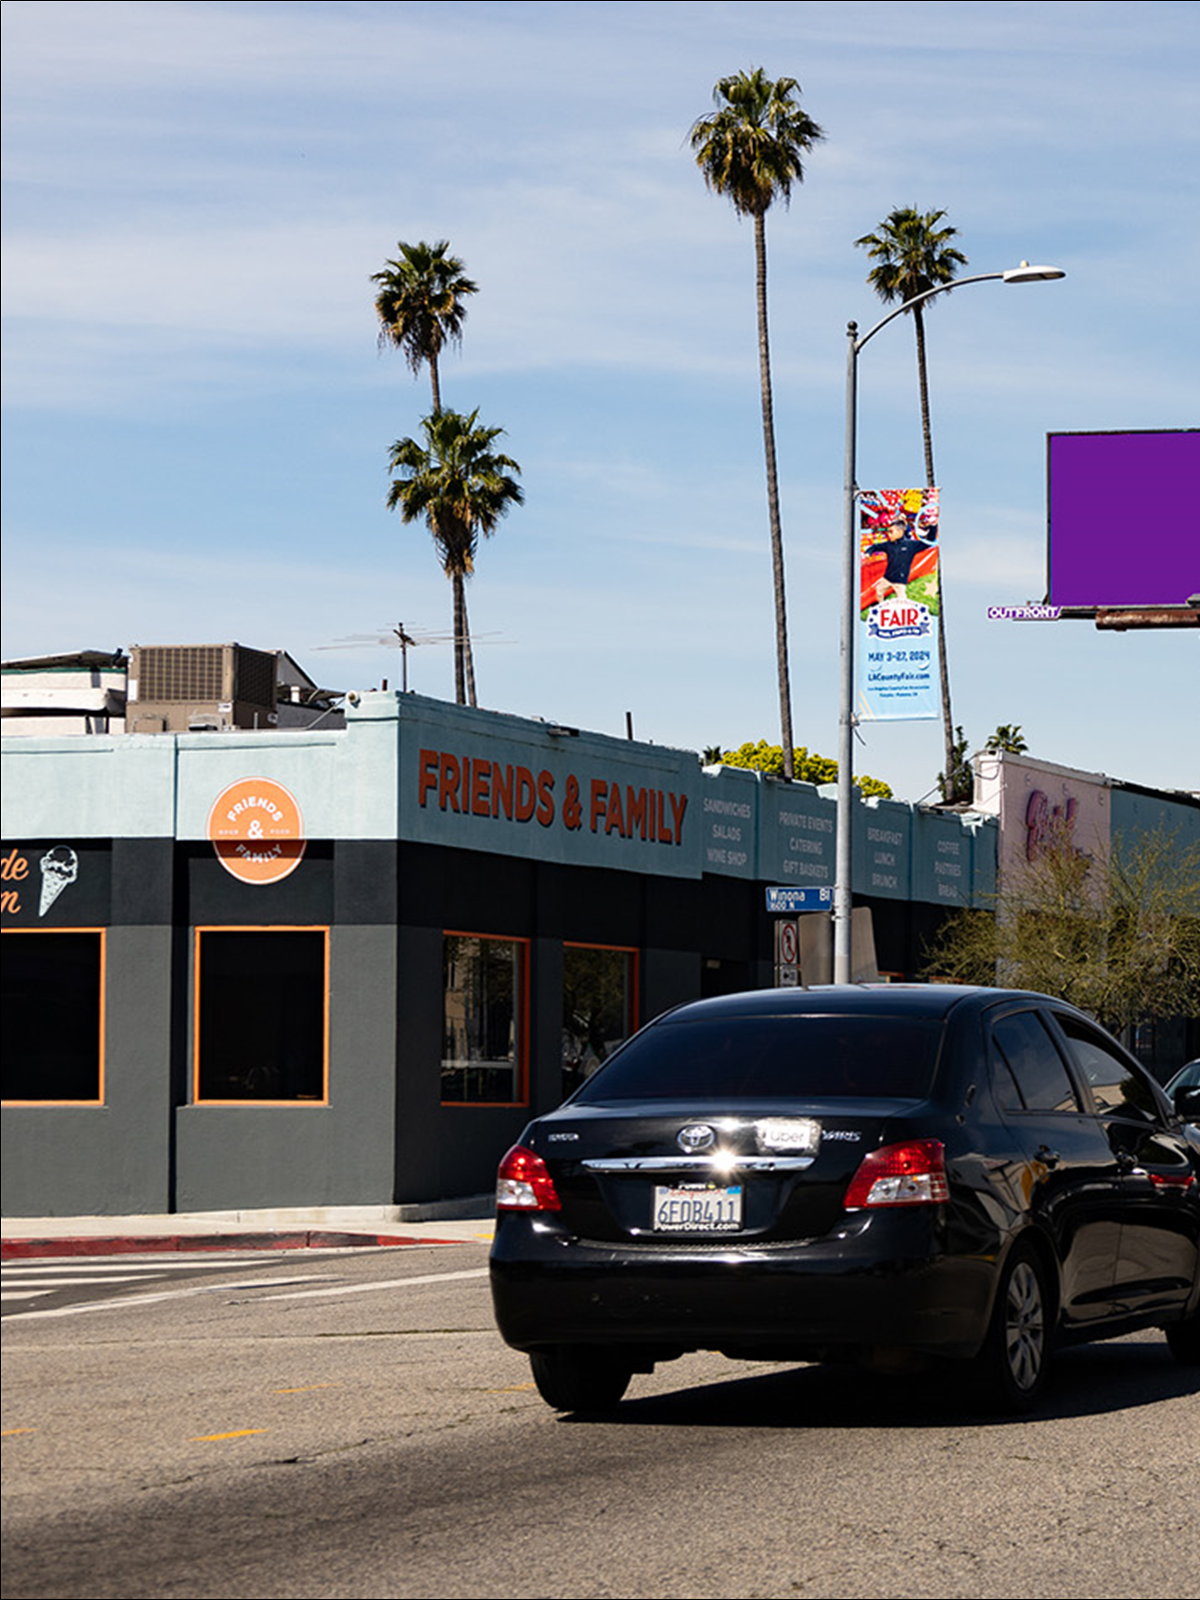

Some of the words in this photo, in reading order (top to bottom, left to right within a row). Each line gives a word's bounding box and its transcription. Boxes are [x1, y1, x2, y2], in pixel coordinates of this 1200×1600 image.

[880, 608, 919, 628] FAIR
[989, 607, 1058, 619] OUTFRONT
[867, 652, 885, 662] MAY
[418, 748, 555, 828] FRIENDS
[562, 774, 582, 831] &
[590, 778, 688, 846] FAMILY
[227, 796, 284, 822] FRIENDS
[703, 798, 752, 819] SANDWICHES
[247, 819, 264, 839] &
[779, 810, 806, 828] PRIVATE
[807, 815, 833, 834] EVENTS
[712, 824, 742, 841] SALADS
[235, 844, 283, 864] FAMILY
[789, 837, 823, 855] CATERING
[706, 848, 726, 864] WINE
[727, 850, 747, 866] SHOP
[783, 859, 798, 874] GIFT
[799, 862, 829, 879] BASKETS
[769, 889, 806, 902] Winona
